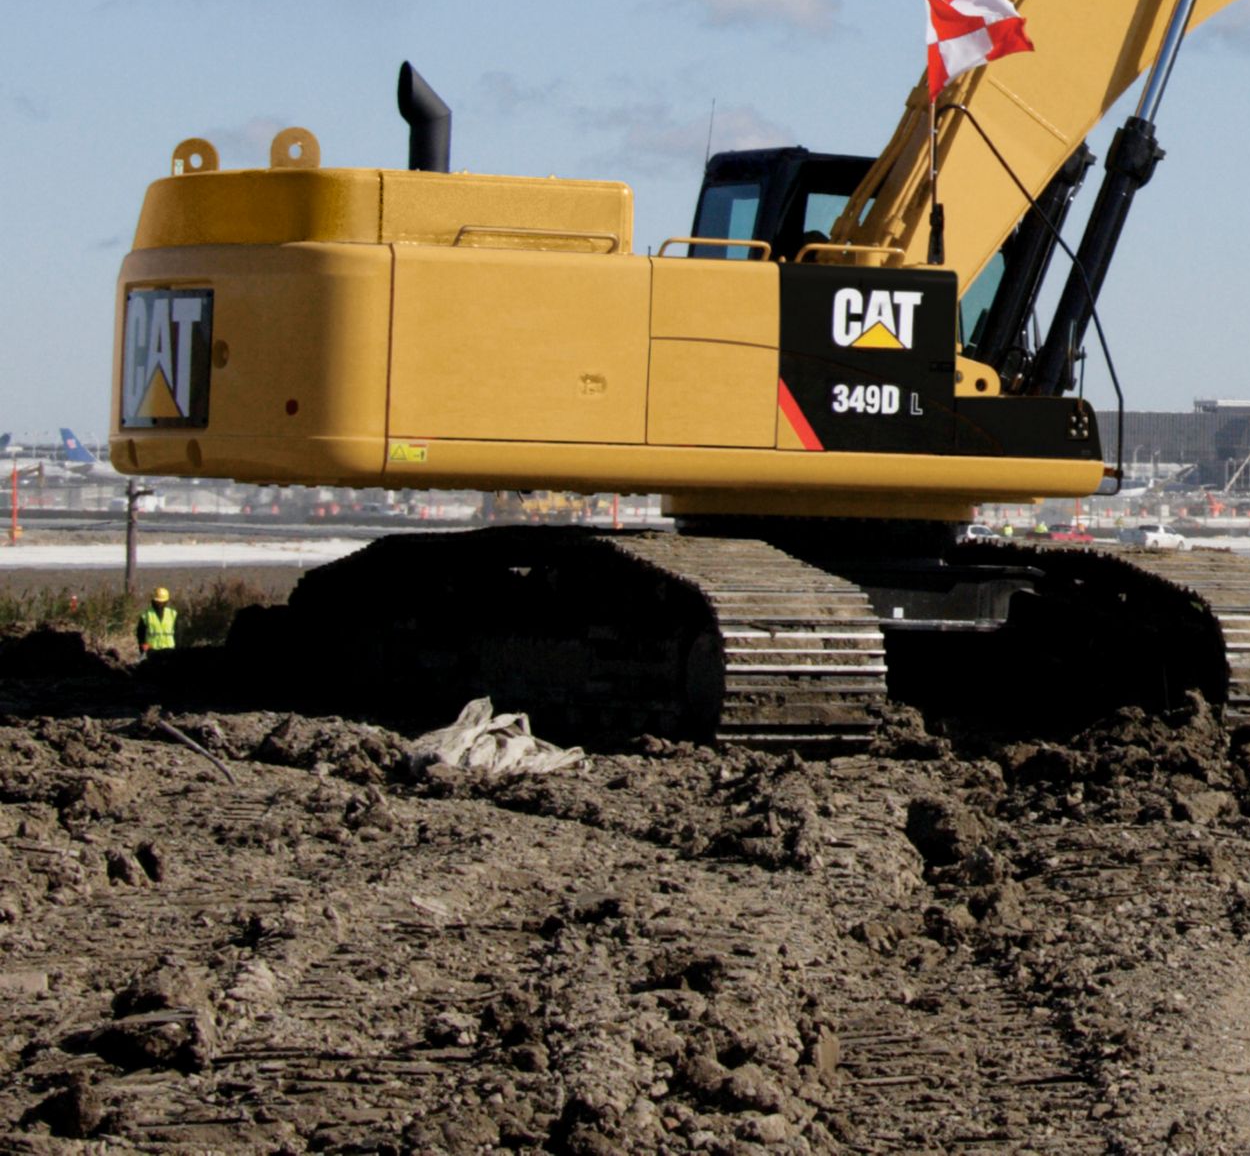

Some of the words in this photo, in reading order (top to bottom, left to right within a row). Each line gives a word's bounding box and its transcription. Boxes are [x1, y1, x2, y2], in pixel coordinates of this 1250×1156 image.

[833, 287, 923, 349] CAT
[123, 297, 202, 418] CAT
[832, 384, 900, 415] 349D
[910, 392, 923, 415] L
